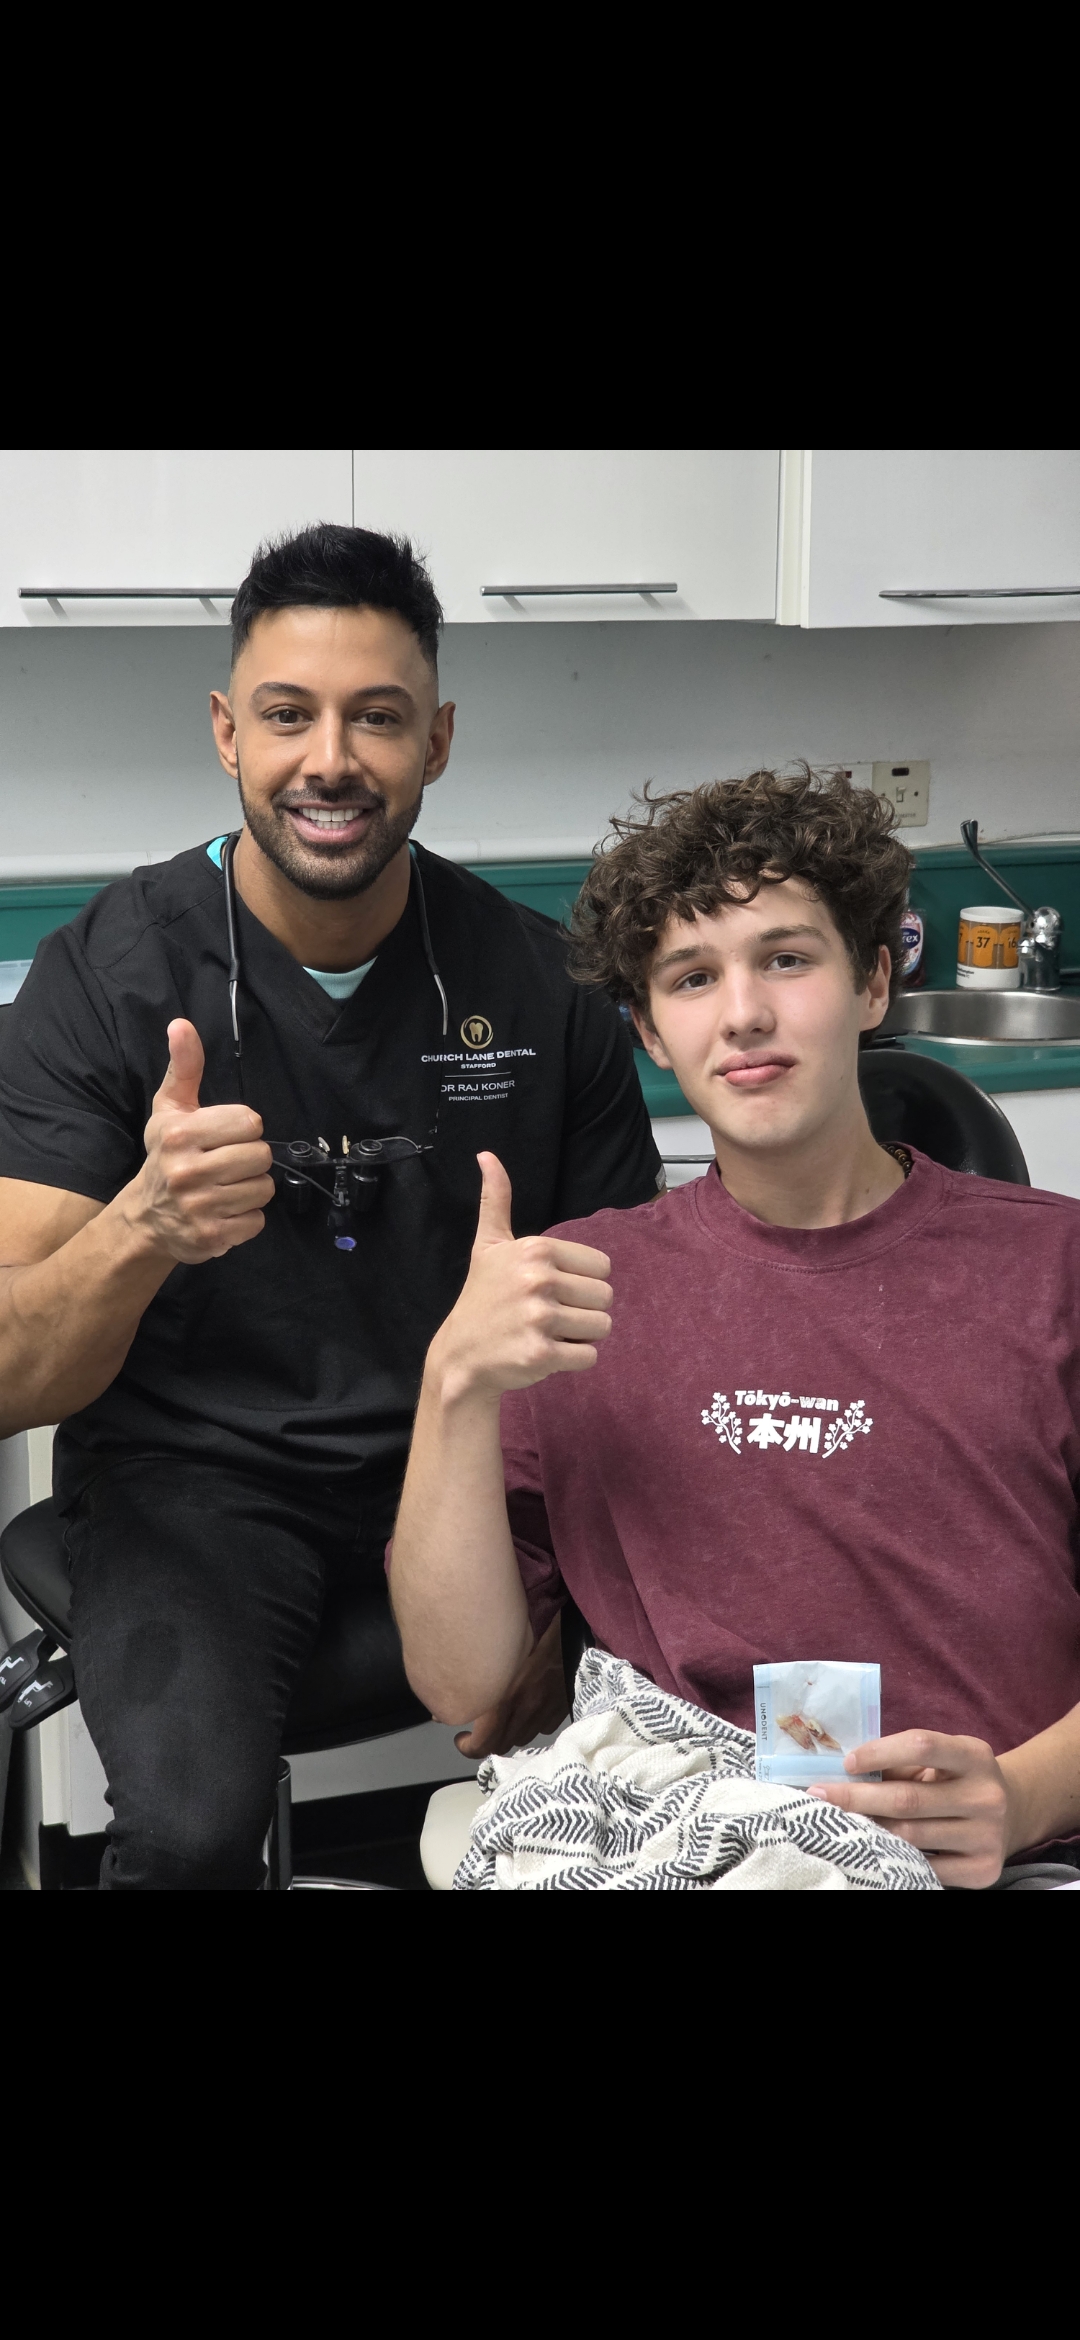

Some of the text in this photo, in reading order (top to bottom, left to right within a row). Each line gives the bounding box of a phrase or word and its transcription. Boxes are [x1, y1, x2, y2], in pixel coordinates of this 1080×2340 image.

[976, 936, 991, 949] 37
[421, 1048, 537, 1063] CHURCH LANE DENTAL
[460, 1062, 497, 1070] STAFFORD
[440, 1079, 516, 1093] DR RAJ KONER
[483, 1092, 509, 1101] DENTIST
[746, 1412, 822, 1454] 本州
